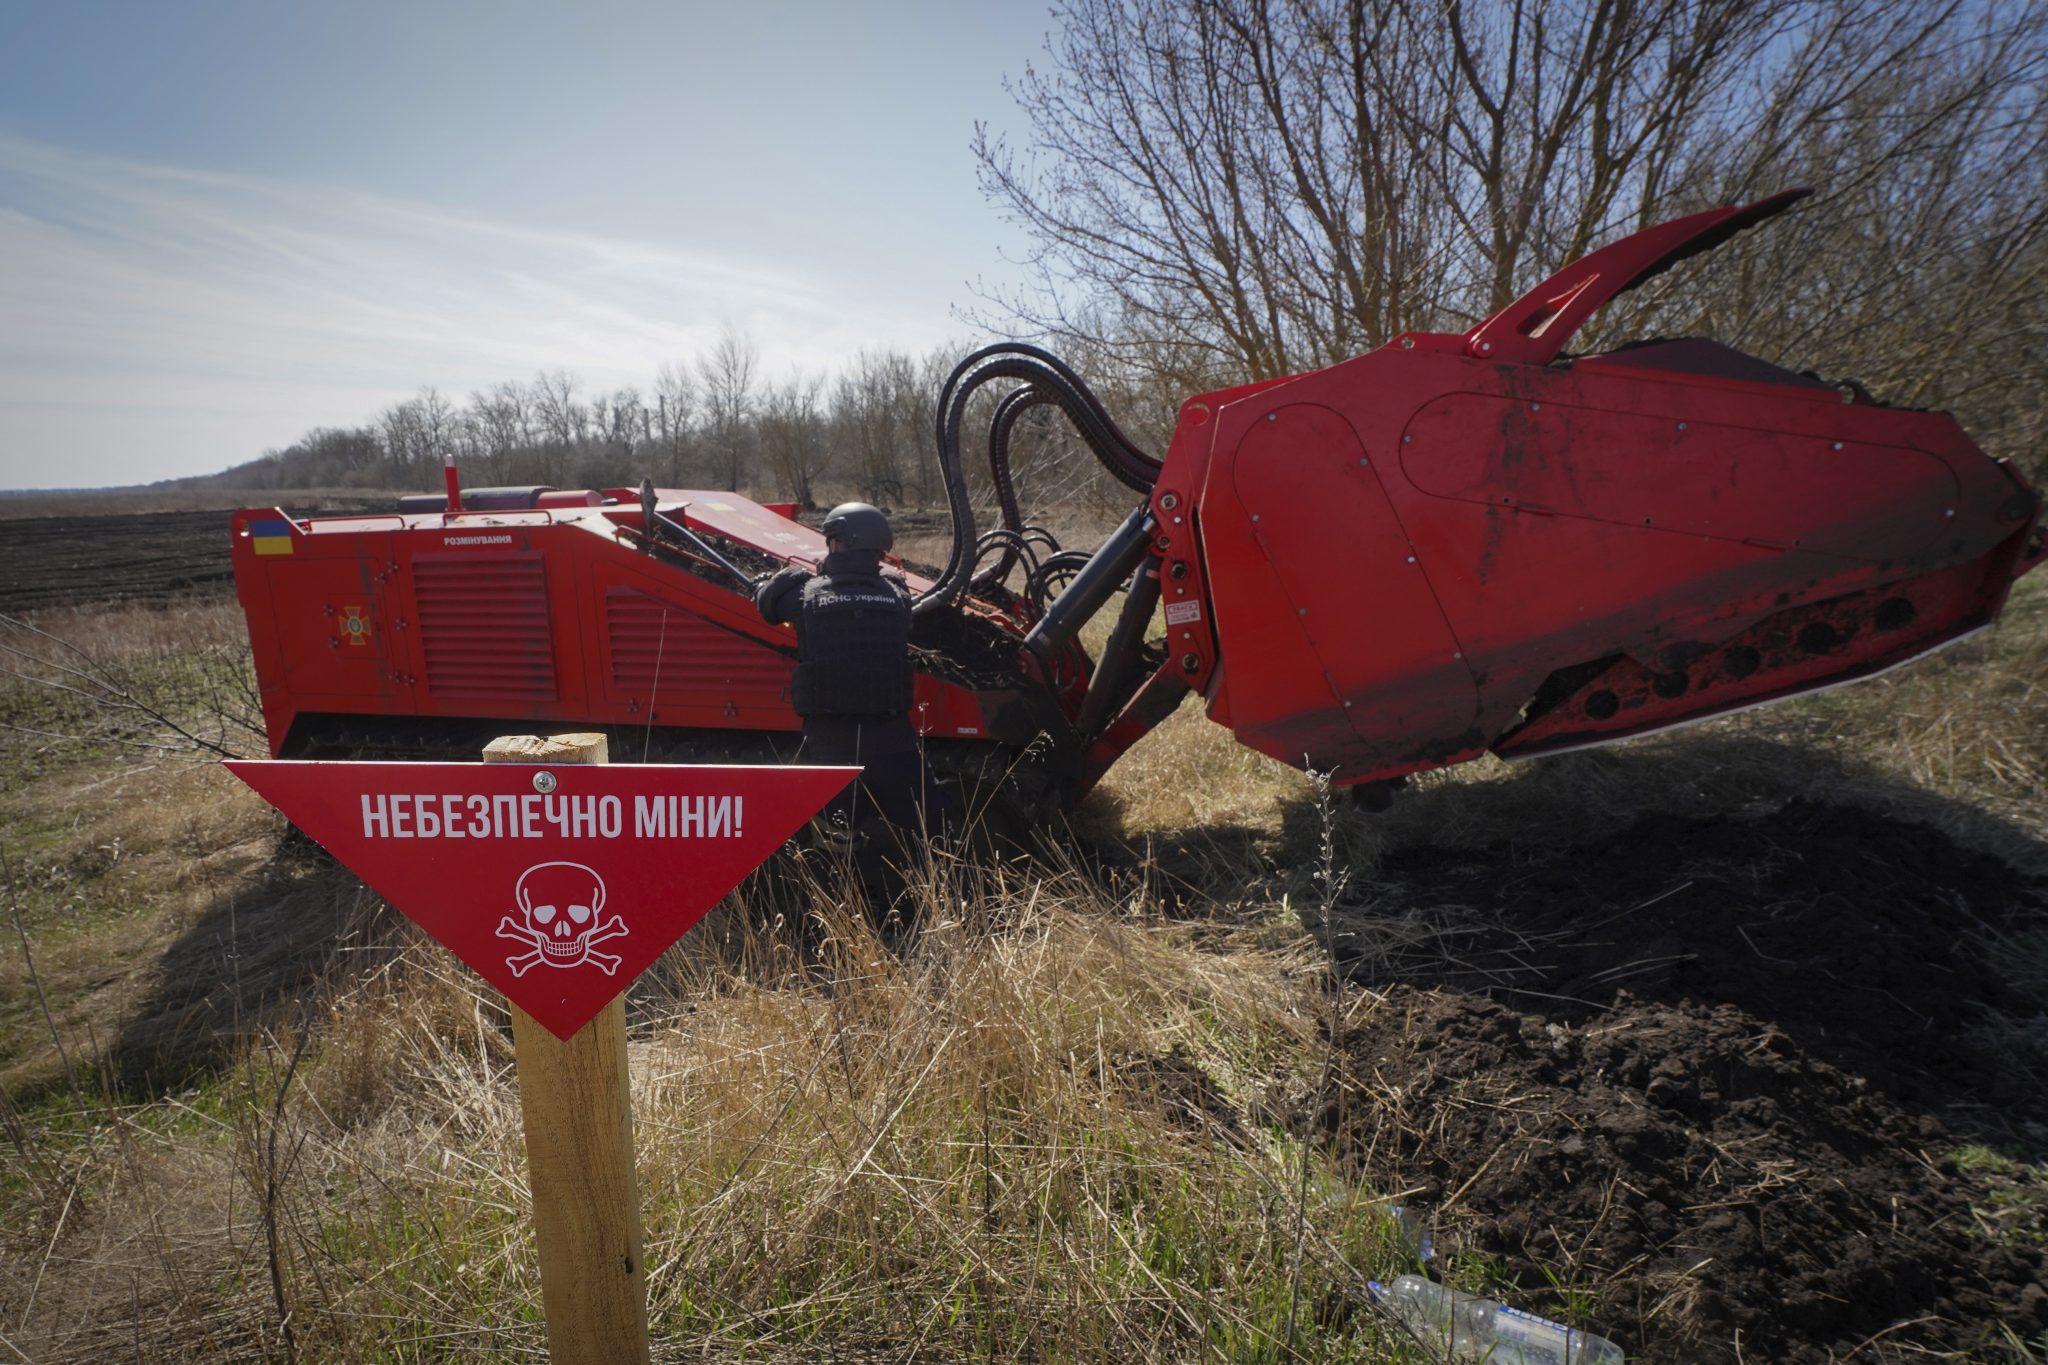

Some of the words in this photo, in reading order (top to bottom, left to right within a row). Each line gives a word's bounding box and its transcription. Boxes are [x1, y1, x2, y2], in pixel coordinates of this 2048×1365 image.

[444, 534, 512, 546] РОЗМІНУВАННЯ
[818, 594, 852, 607] ДСНС
[855, 594, 896, 604] України
[361, 794, 622, 839] НЕБЕЗПЕЧНО
[635, 795, 743, 838] МІНИ!
